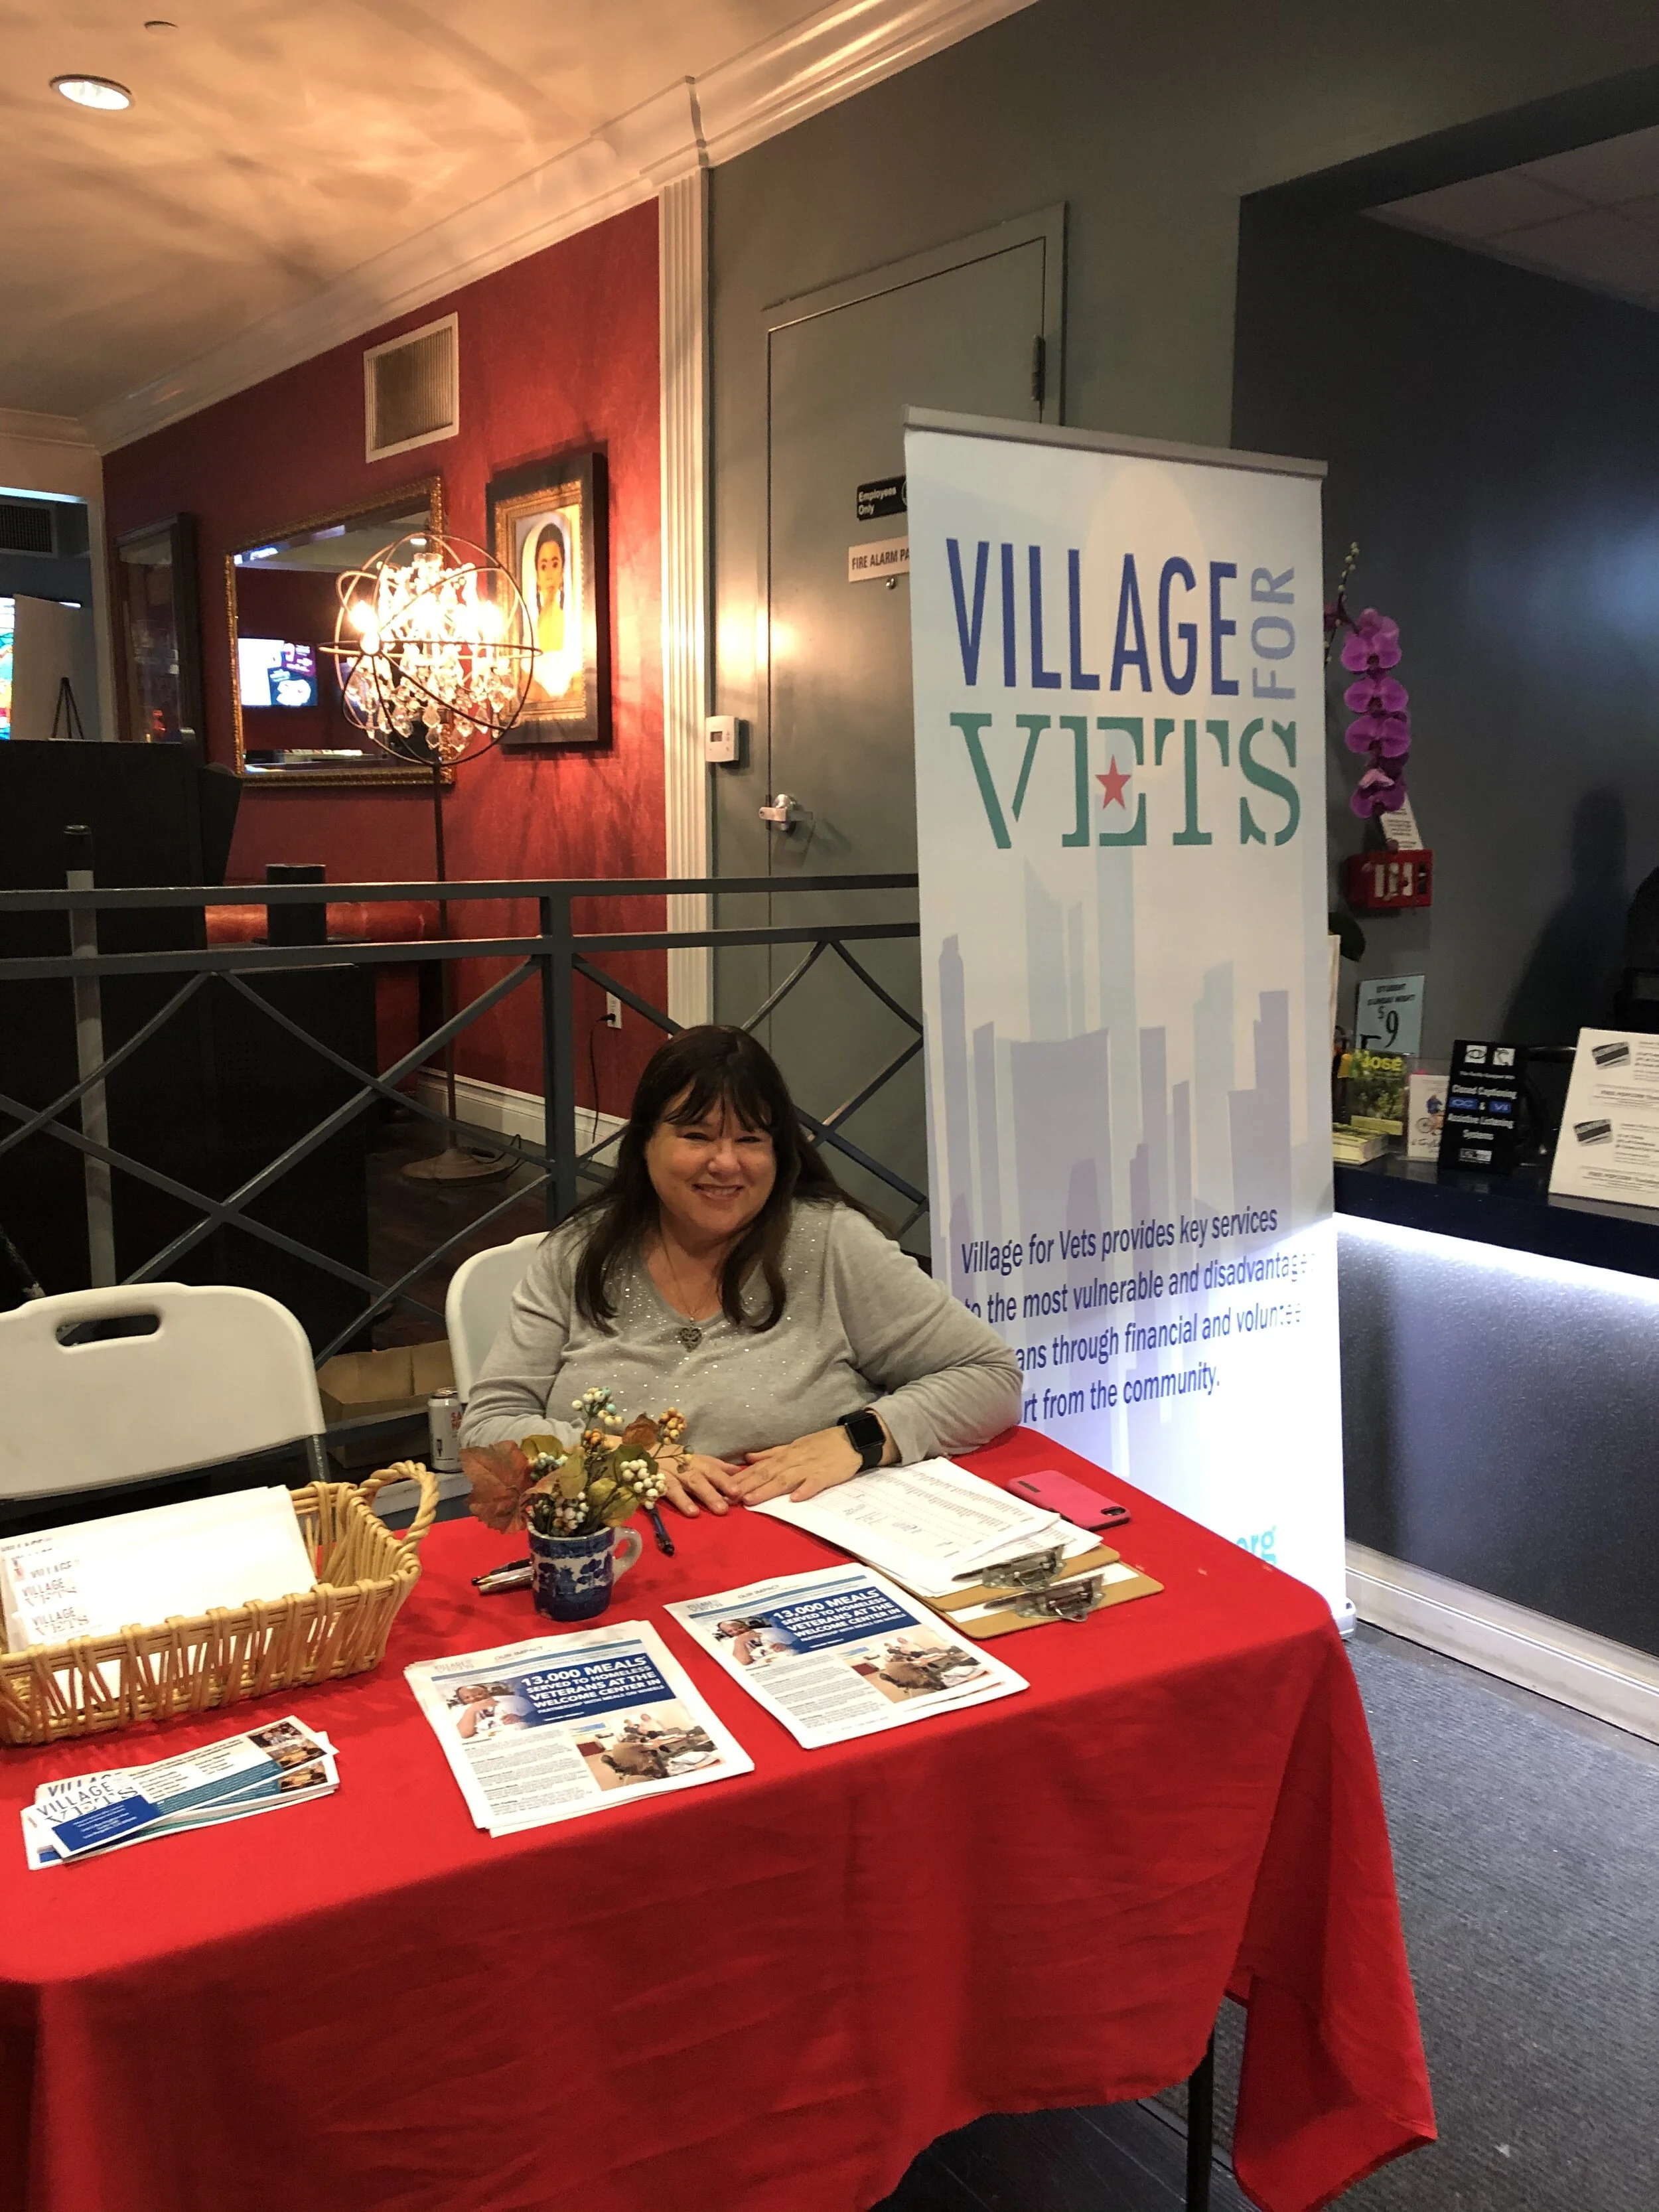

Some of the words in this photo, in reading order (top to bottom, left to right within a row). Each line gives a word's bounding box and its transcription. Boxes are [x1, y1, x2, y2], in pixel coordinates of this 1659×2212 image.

[859, 486, 897, 502] Employees
[858, 504, 875, 516] Only
[852, 555, 868, 570] FIRE
[870, 550, 897, 566] ALARM
[946, 538, 1240, 696] VILLAGE
[1251, 567, 1296, 700] FOR
[950, 713, 1301, 849] VETS
[962, 1240, 1023, 1276] Village
[1029, 1233, 1054, 1264] for
[1059, 1229, 1096, 1260] Vets
[1102, 1219, 1175, 1261] provides
[1180, 1215, 1208, 1248] key
[1212, 1205, 1277, 1238] services
[987, 1293, 1017, 1323] the
[1023, 1284, 1068, 1318] most
[1073, 1270, 1163, 1310] vulnerable
[1169, 1263, 1199, 1295] and
[1052, 1327, 1118, 1364] through
[1125, 1313, 1197, 1353] financial
[1202, 1307, 1231, 1340] and
[1043, 1388, 1084, 1420] from
[1090, 1380, 1118, 1410] the
[1123, 1362, 1220, 1403] community.
[22, 1578, 65, 1597] VILLAGE
[32, 1607, 76, 1626] VILLAGE
[773, 1602, 825, 1619] 13,000
[825, 1589, 880, 1607] MEALS
[781, 1613, 821, 1625] SERVED
[835, 1597, 887, 1613] HOMELESS
[786, 1613, 853, 1631] VETERANS
[853, 1608, 870, 1617] AT
[868, 1602, 895, 1613] THE
[35, 1615, 90, 1636] VETS
[794, 1621, 849, 1637] WELCOME
[848, 1611, 890, 1625] CENTER
[521, 1669, 581, 1686] 13,000
[584, 1657, 647, 1676] MEALS
[526, 1681, 571, 1694] SERVED
[591, 1665, 652, 1682] HOMELESS
[530, 1682, 607, 1700] VETERANS
[608, 1678, 626, 1687] AT
[626, 1671, 657, 1683] THE
[533, 1692, 597, 1708] WELCOME
[599, 1682, 646, 1696] CENTER
[36, 1782, 114, 1816] VILLAGE
